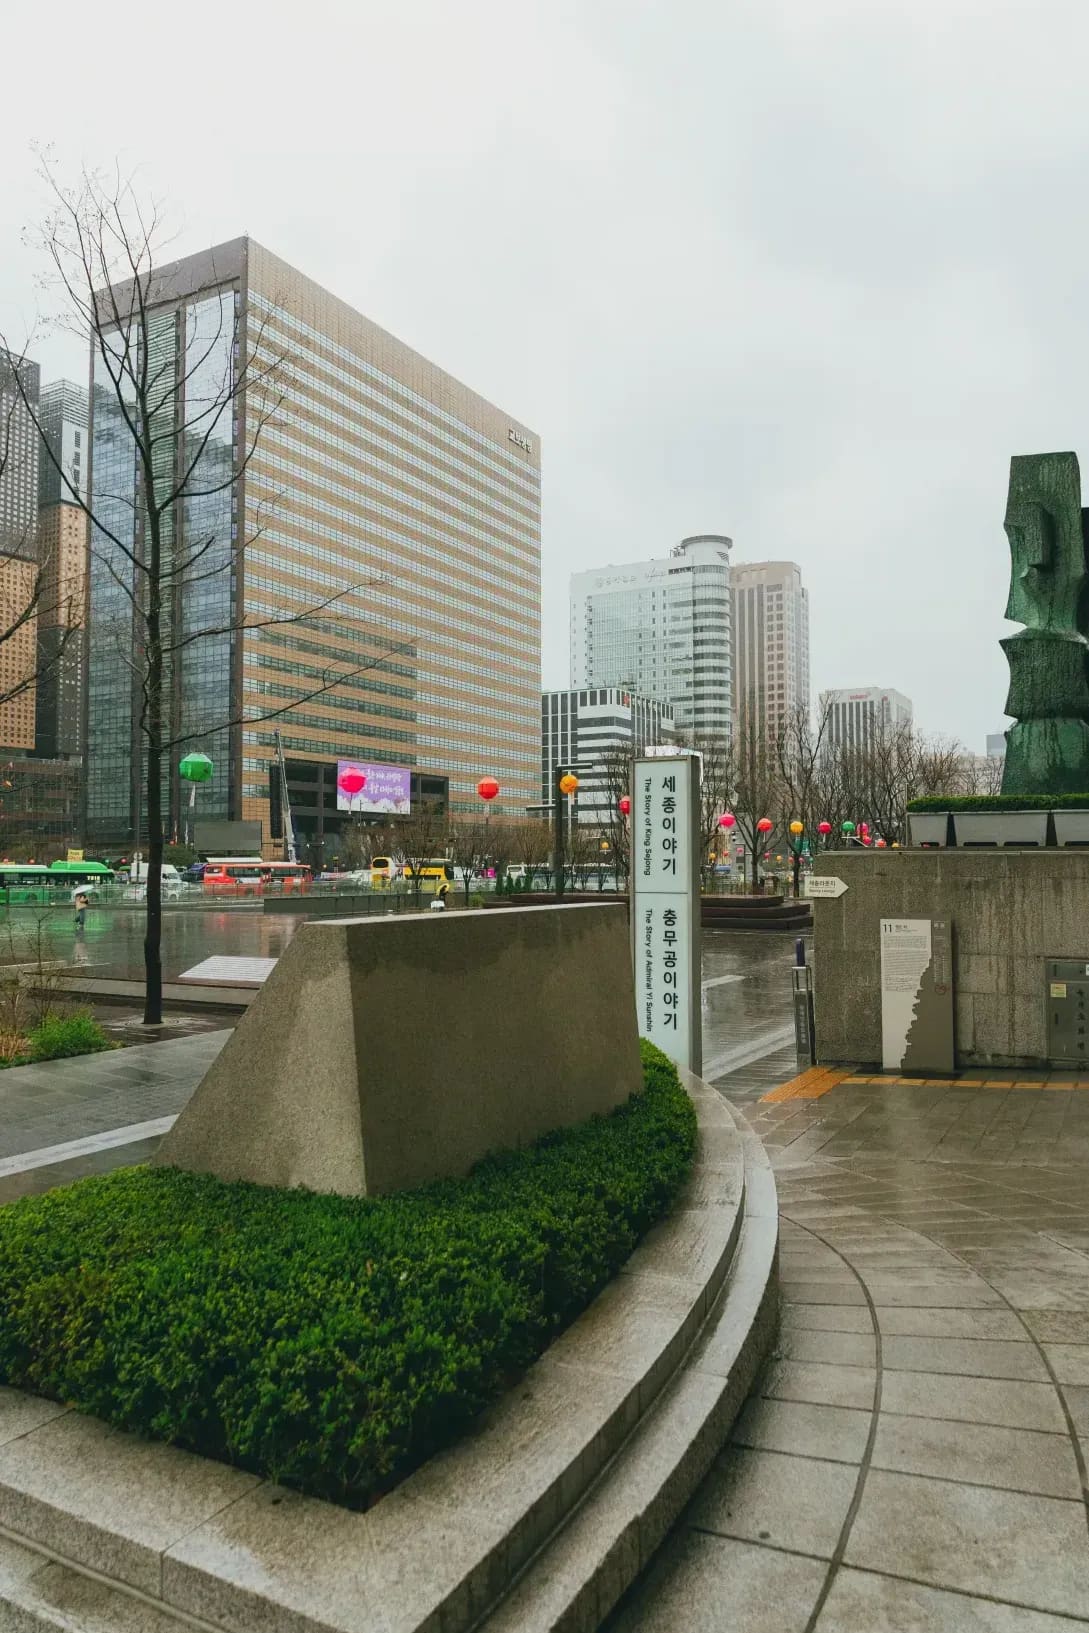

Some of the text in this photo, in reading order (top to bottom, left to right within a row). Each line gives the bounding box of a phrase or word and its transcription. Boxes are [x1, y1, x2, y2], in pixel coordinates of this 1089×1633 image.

[644, 777, 652, 876] The Story of King Sejong
[661, 775, 677, 876] 세종이야기
[645, 908, 653, 924] The
[644, 926, 653, 947] Story
[883, 923, 892, 934] 11
[645, 950, 653, 958] of
[645, 960, 653, 990] Admiral
[662, 908, 679, 1030] 충무공이야기
[645, 992, 653, 1000] Yi
